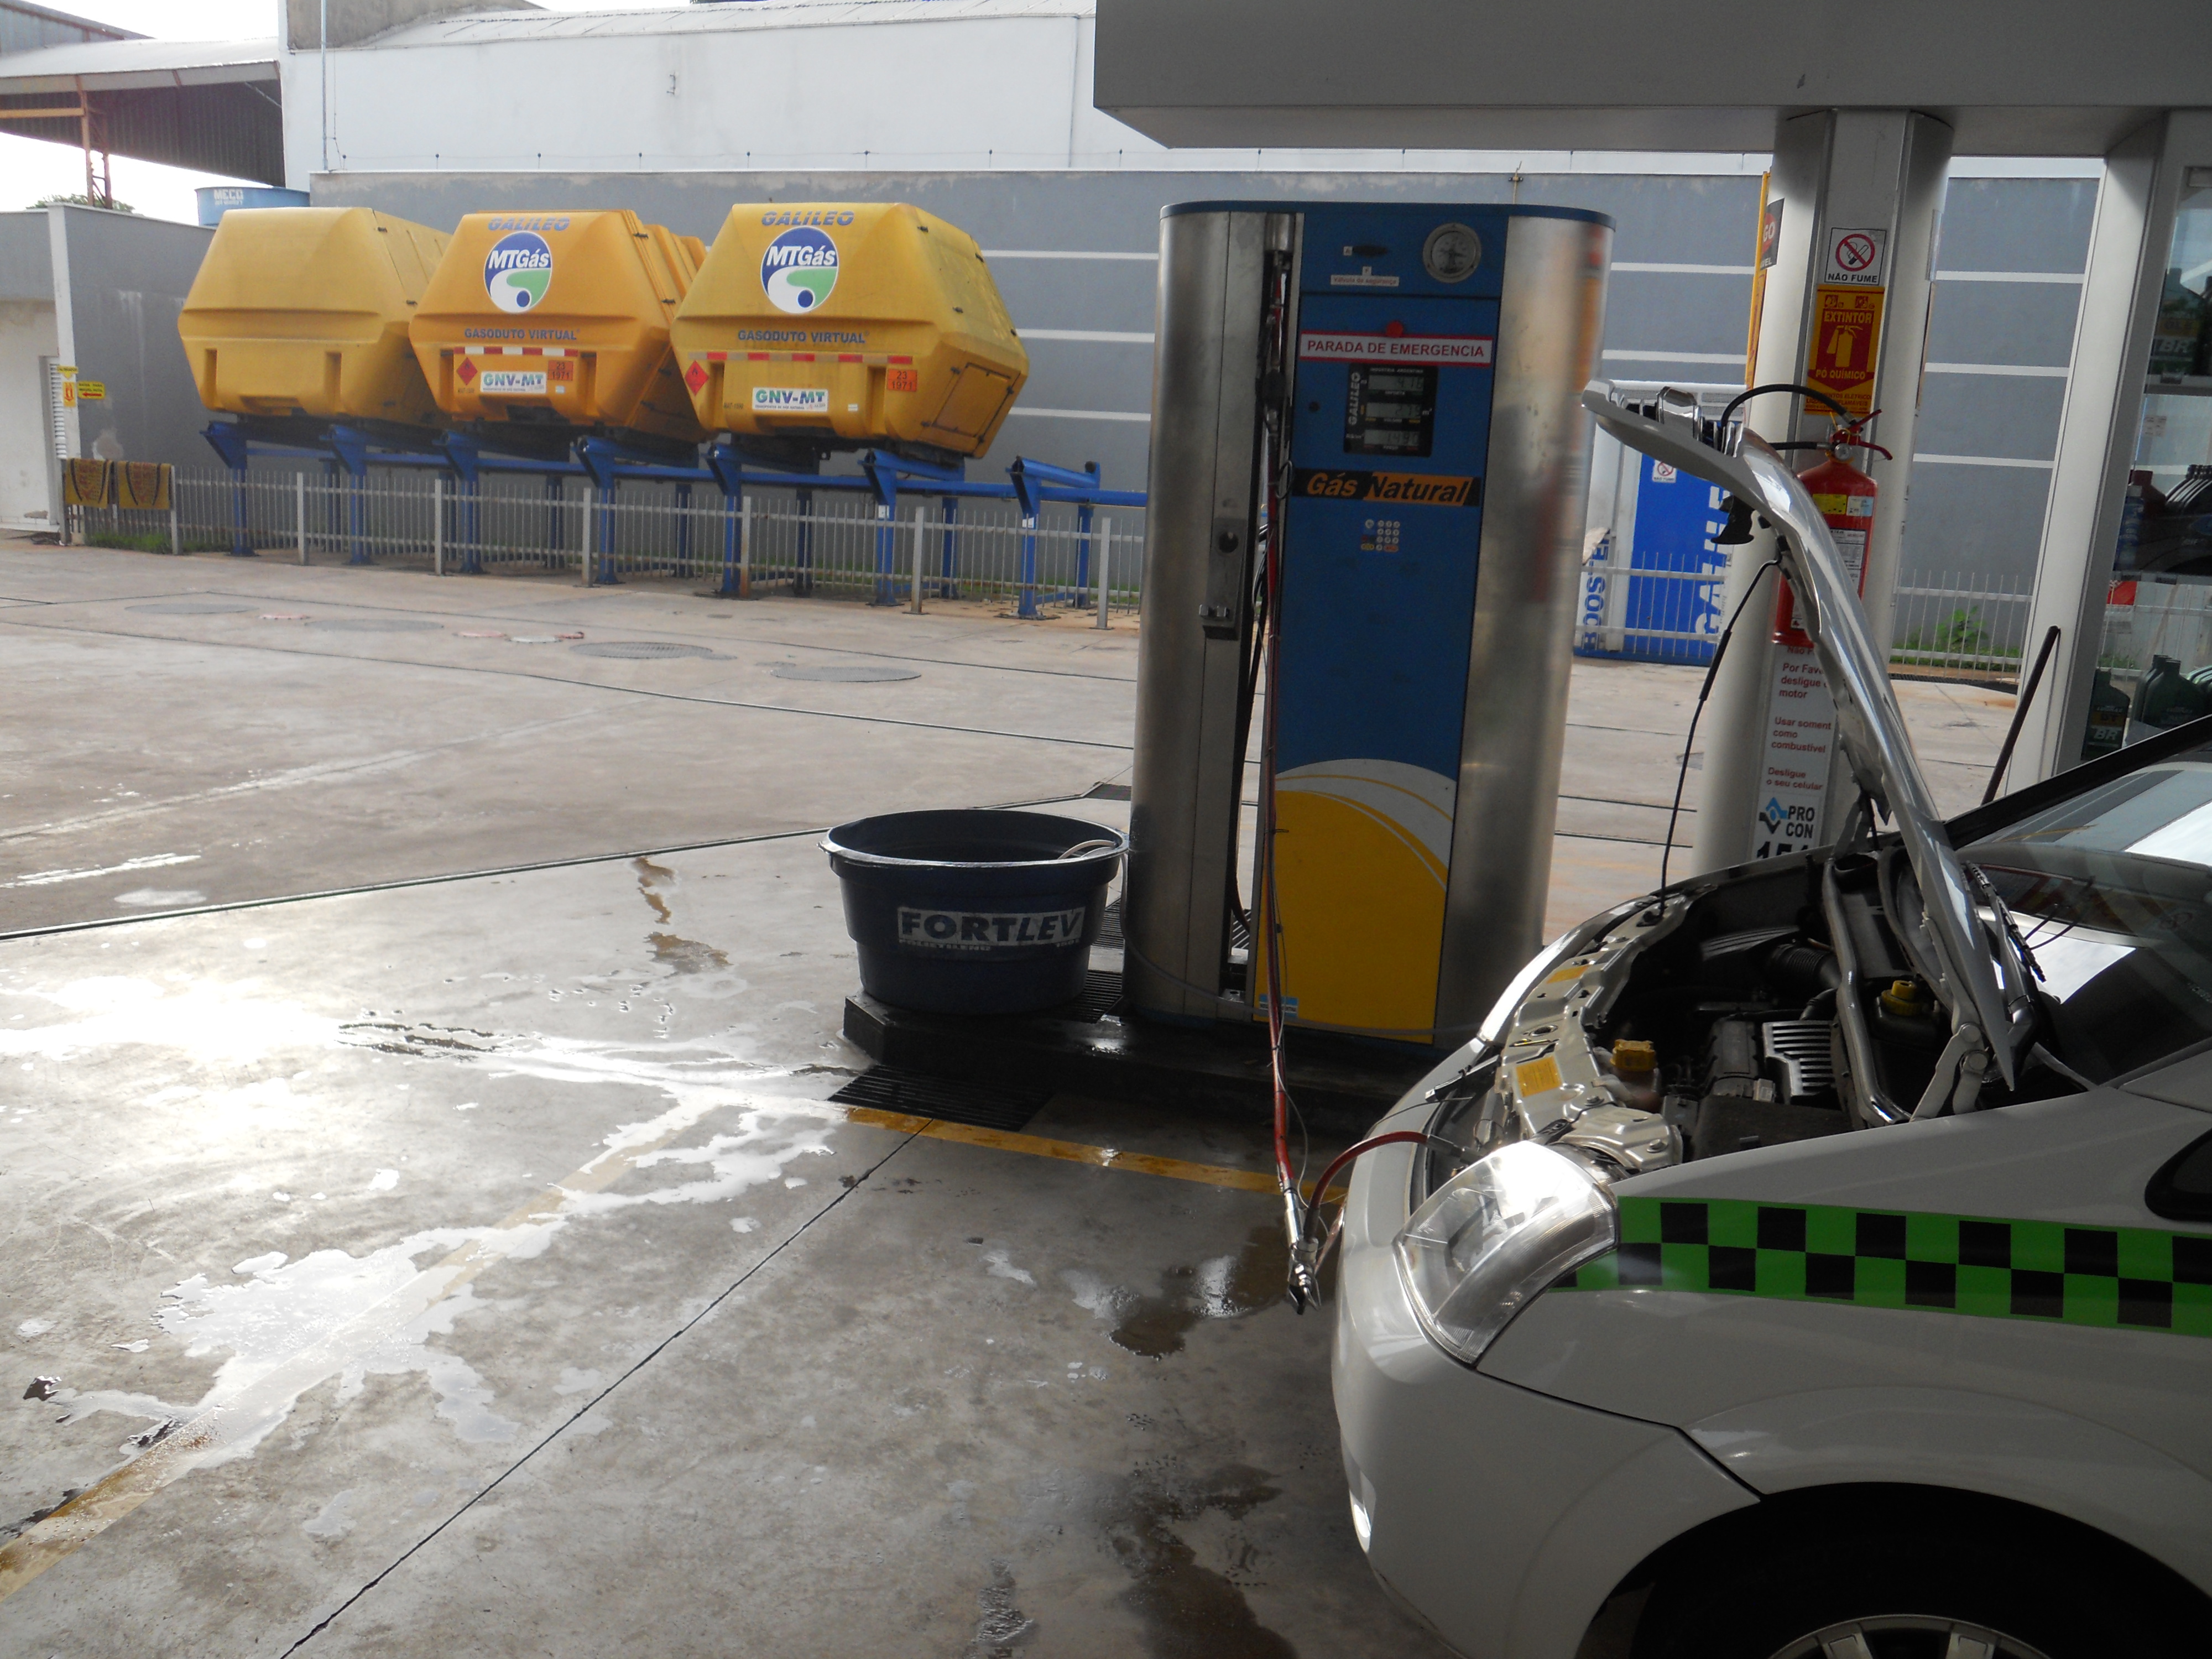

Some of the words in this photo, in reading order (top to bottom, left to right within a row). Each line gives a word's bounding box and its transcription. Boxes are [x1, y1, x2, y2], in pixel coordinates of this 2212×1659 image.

[488, 216, 570, 231] GALILEO
[761, 211, 854, 226] GALILEO
[1764, 222, 1775, 242] GO
[488, 249, 549, 269] MTGás
[766, 246, 836, 266] MTGás
[1827, 272, 1848, 281] NÃO
[1851, 274, 1877, 283] FUME
[1824, 312, 1873, 324] EXTINTOR
[465, 328, 525, 338] GASODUTO
[738, 329, 806, 342] GASODUTO
[1308, 340, 1364, 353] PARADA
[1368, 342, 1386, 353] DE
[1390, 343, 1484, 357] EMERGENCIA
[557, 362, 565, 370] 23
[483, 372, 544, 387] GNV-MT
[552, 371, 570, 380] 1971
[896, 371, 907, 380] 23
[1815, 367, 1827, 378] PÓ
[1829, 368, 1866, 380] QUÍMICO
[891, 380, 913, 390] 1971
[755, 389, 826, 404] GNV-MT
[1348, 372, 1361, 426] GALILEO
[1307, 472, 1358, 497] Gás
[1368, 476, 1469, 503] Natural
[1581, 528, 1610, 650] BOOSE
[1782, 663, 1799, 672] Por
[1802, 664, 1824, 675] Fav
[1781, 676, 1821, 688] desligue
[1779, 689, 1807, 699] motor
[1775, 717, 1795, 726] Usar
[1773, 730, 1798, 738] como
[2093, 728, 2119, 740] BR
[1771, 741, 1826, 753] combustível
[1768, 767, 1807, 779] Desligue
[1793, 781, 1824, 790] celular
[1788, 805, 1815, 822] PRO
[1786, 822, 1814, 839] CON
[1756, 841, 1808, 859] 15
[901, 911, 1078, 942] FORTLEV
